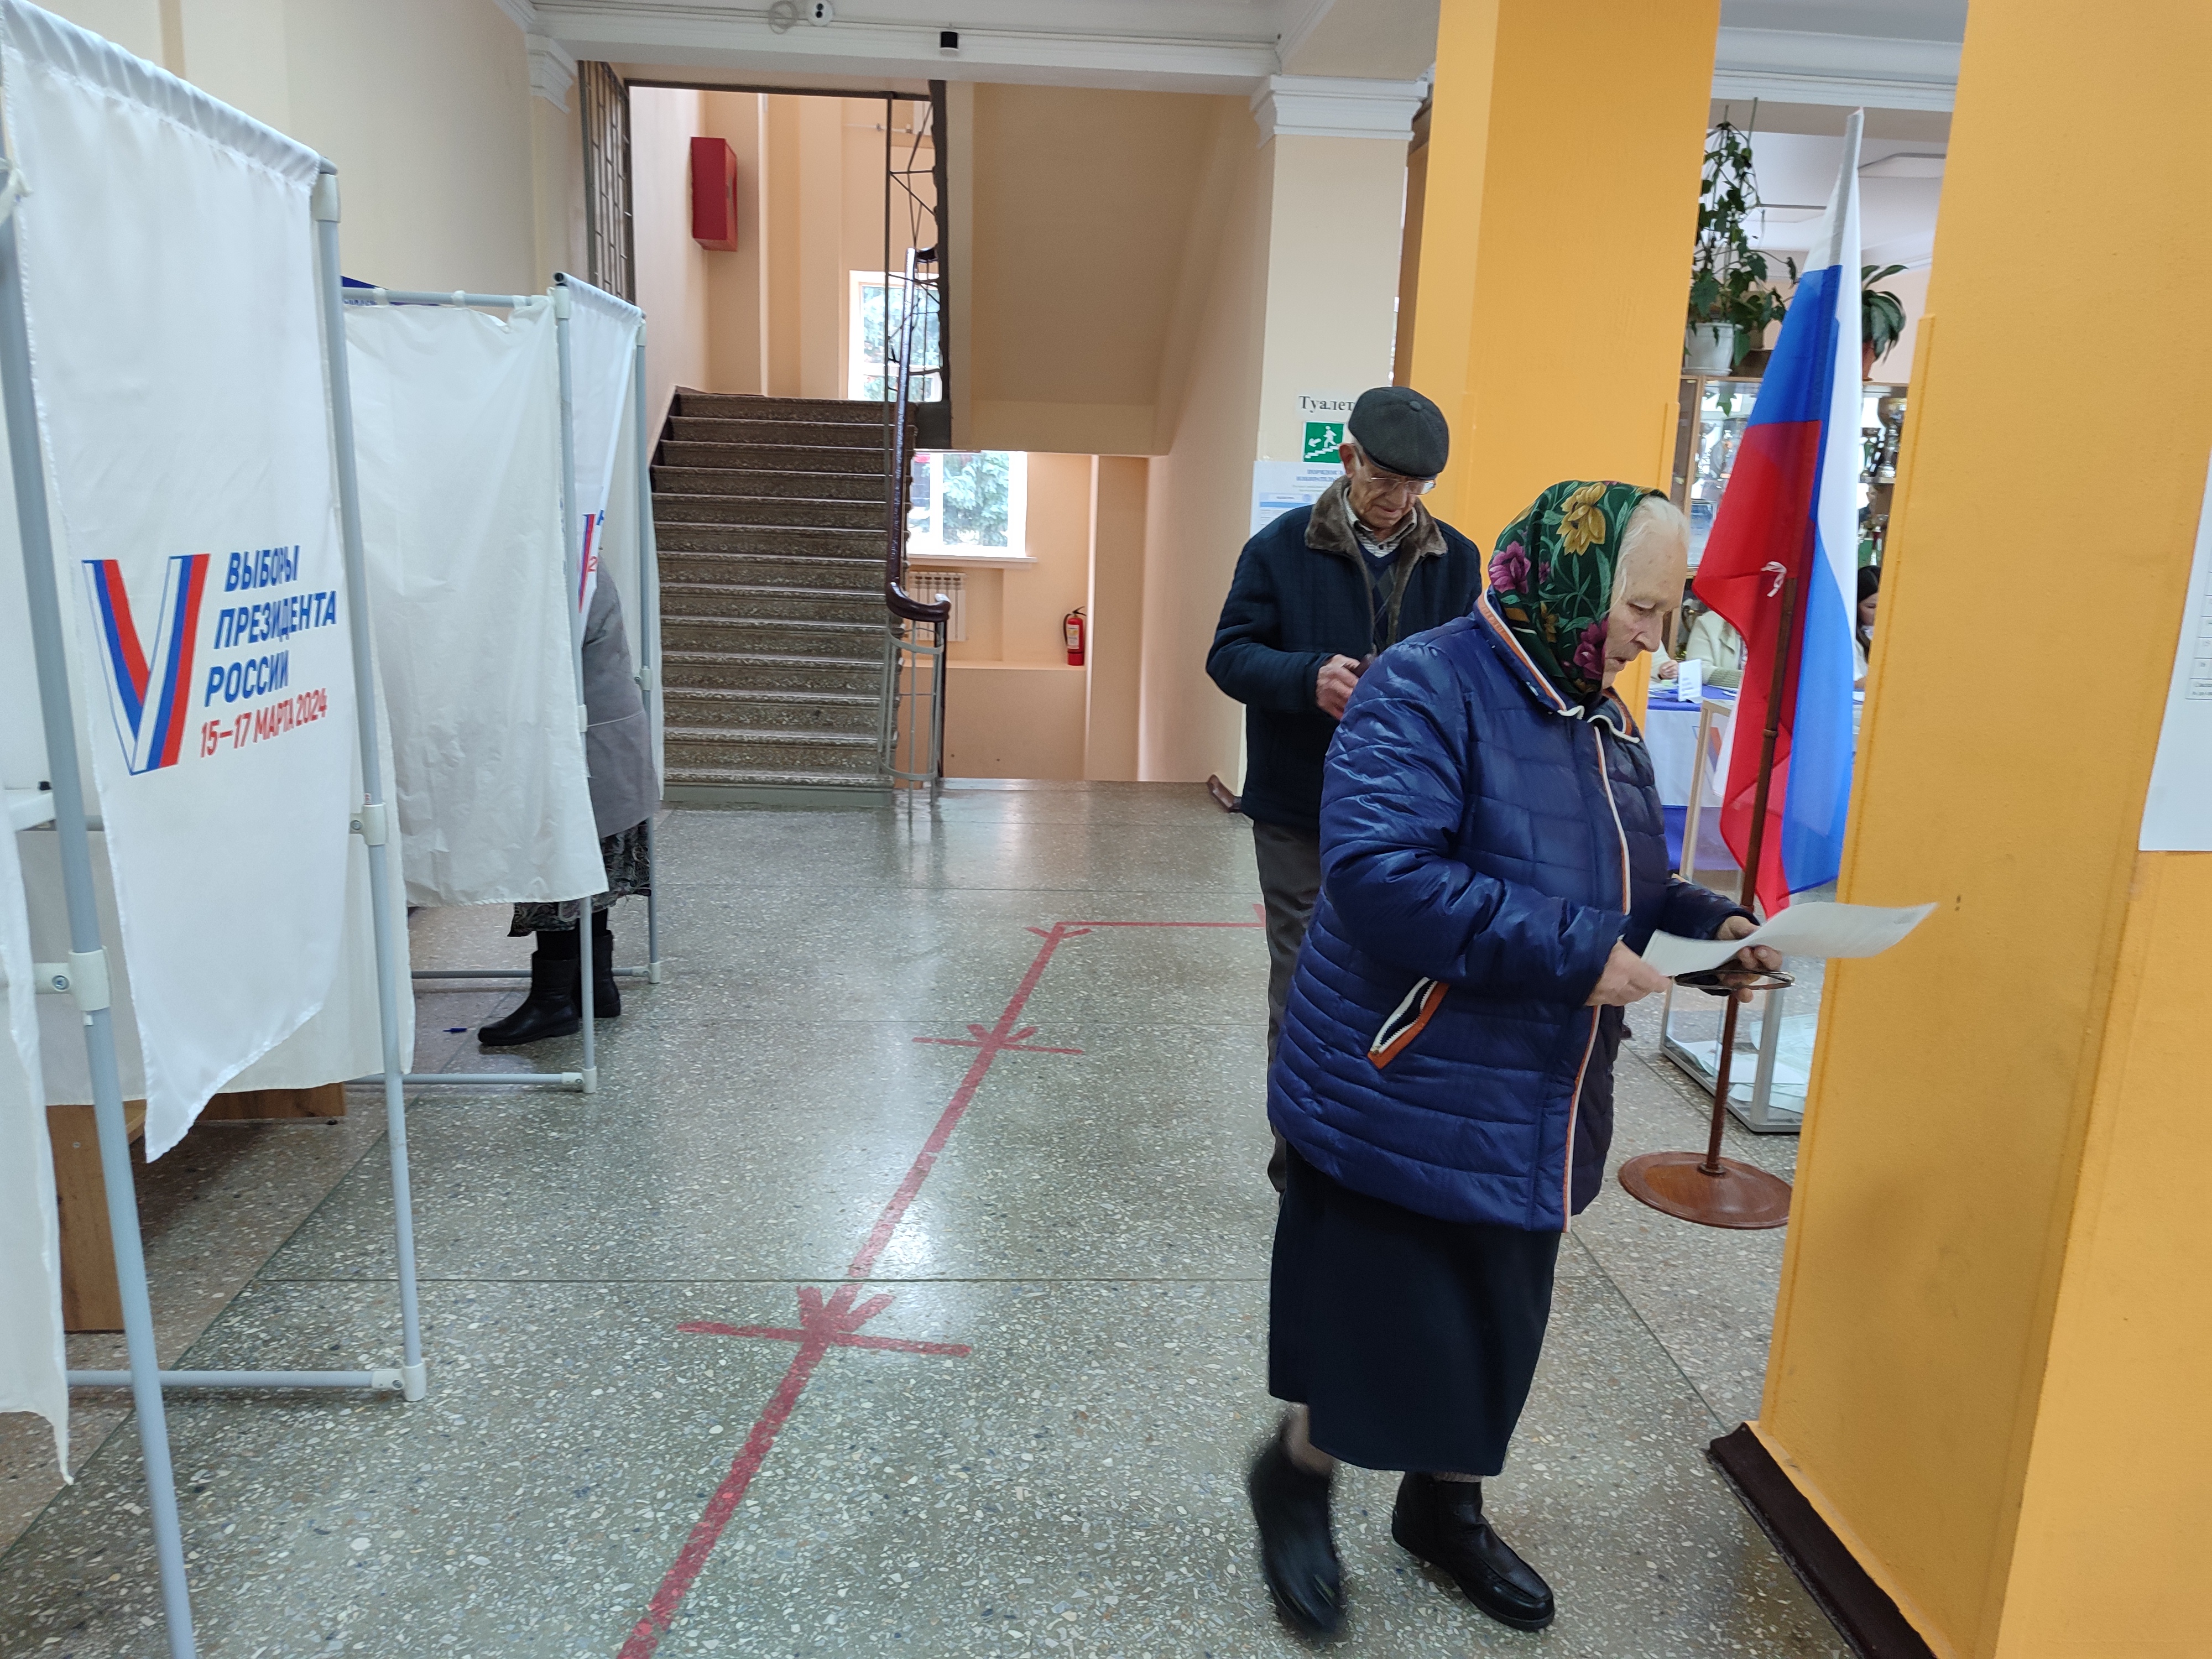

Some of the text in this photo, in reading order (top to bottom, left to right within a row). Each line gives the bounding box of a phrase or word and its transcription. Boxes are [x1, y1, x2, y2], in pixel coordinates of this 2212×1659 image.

[1298, 396, 1355, 413] Туалет
[224, 545, 300, 592] ВЫБОРЫ
[213, 590, 337, 650] ПРЕЗИДЕНТА
[204, 650, 289, 707] РОССИИ
[253, 697, 295, 743] МАРТА
[295, 687, 328, 727] 2024
